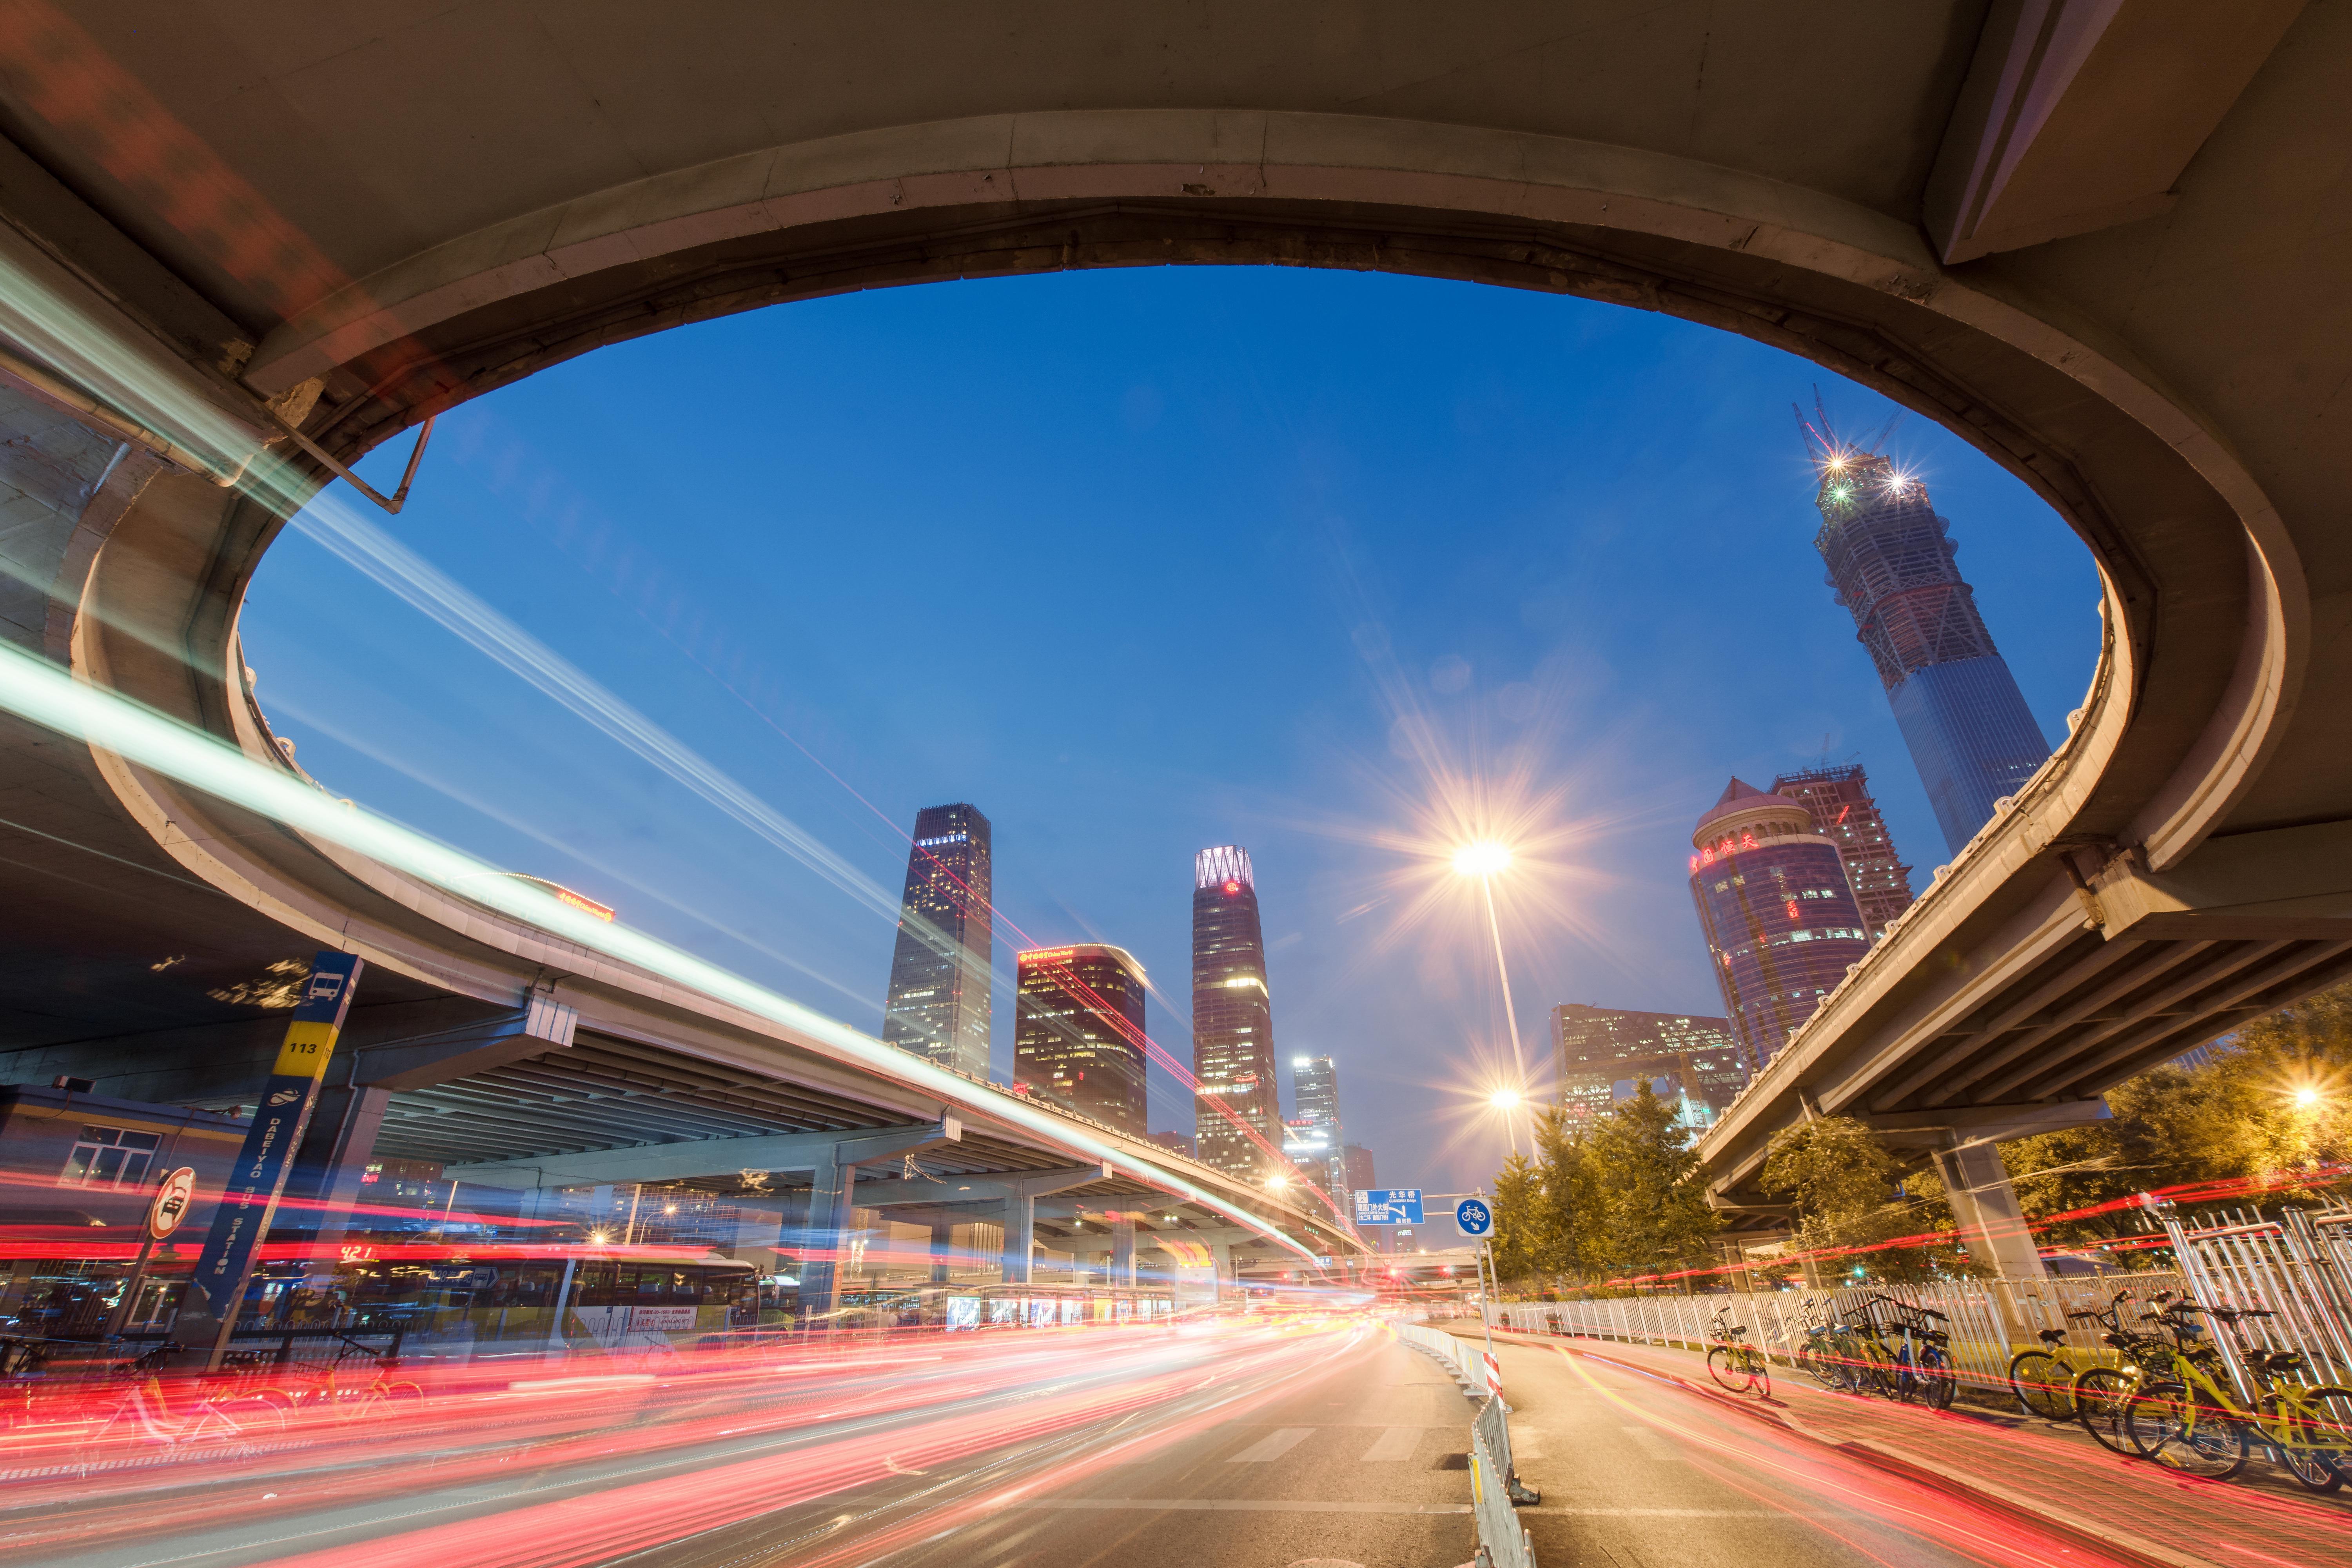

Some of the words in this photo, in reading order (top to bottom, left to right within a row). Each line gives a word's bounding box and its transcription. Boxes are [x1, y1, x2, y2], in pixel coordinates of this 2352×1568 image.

[1691, 835, 1759, 872] 中国恒天
[290, 1043, 317, 1054] 113
[250, 1118, 281, 1178] DABEIYAO
[239, 1186, 255, 1209] BUS
[1389, 1191, 1415, 1199] 光华桥
[214, 1218, 243, 1274] STATION
[341, 1246, 372, 1259] 421
